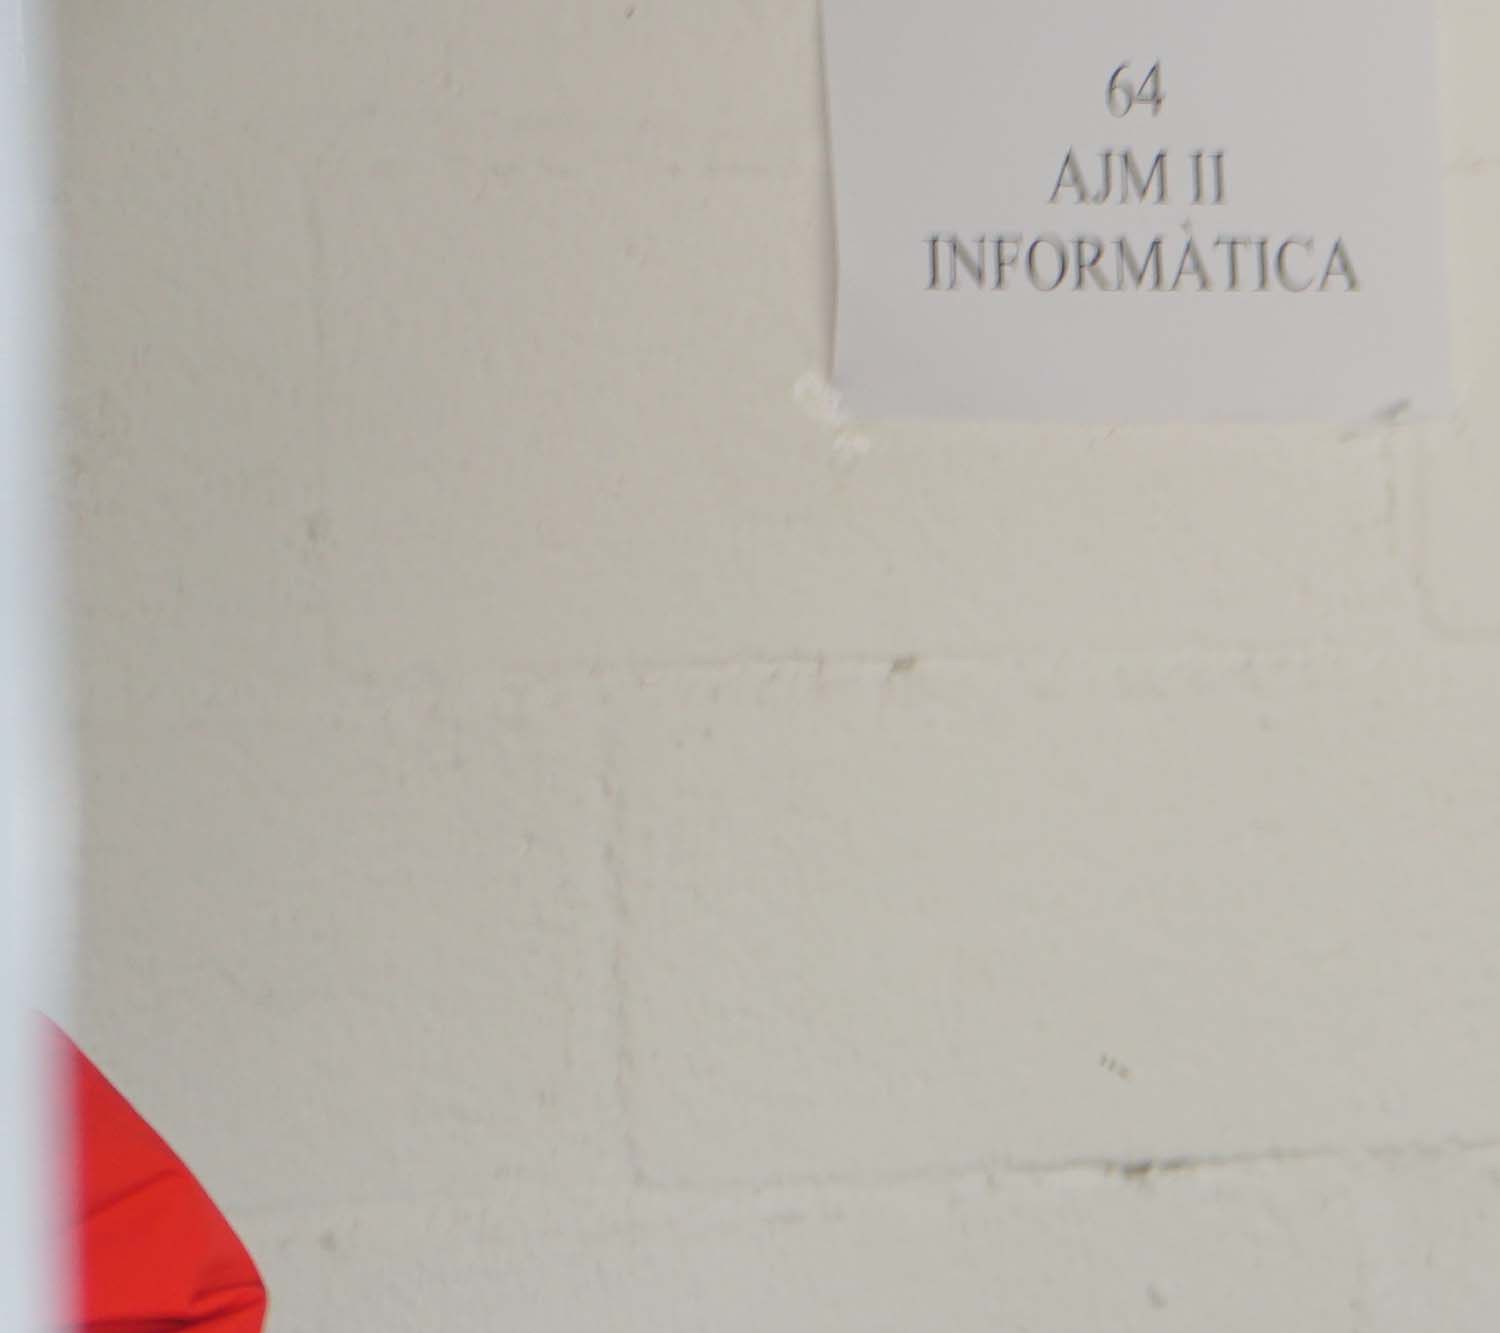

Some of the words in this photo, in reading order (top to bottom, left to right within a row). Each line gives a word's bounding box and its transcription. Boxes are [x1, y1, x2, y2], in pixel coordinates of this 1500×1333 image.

[1105, 60, 1166, 118] 64
[1048, 147, 1168, 206] AJM
[1187, 148, 1229, 206] II
